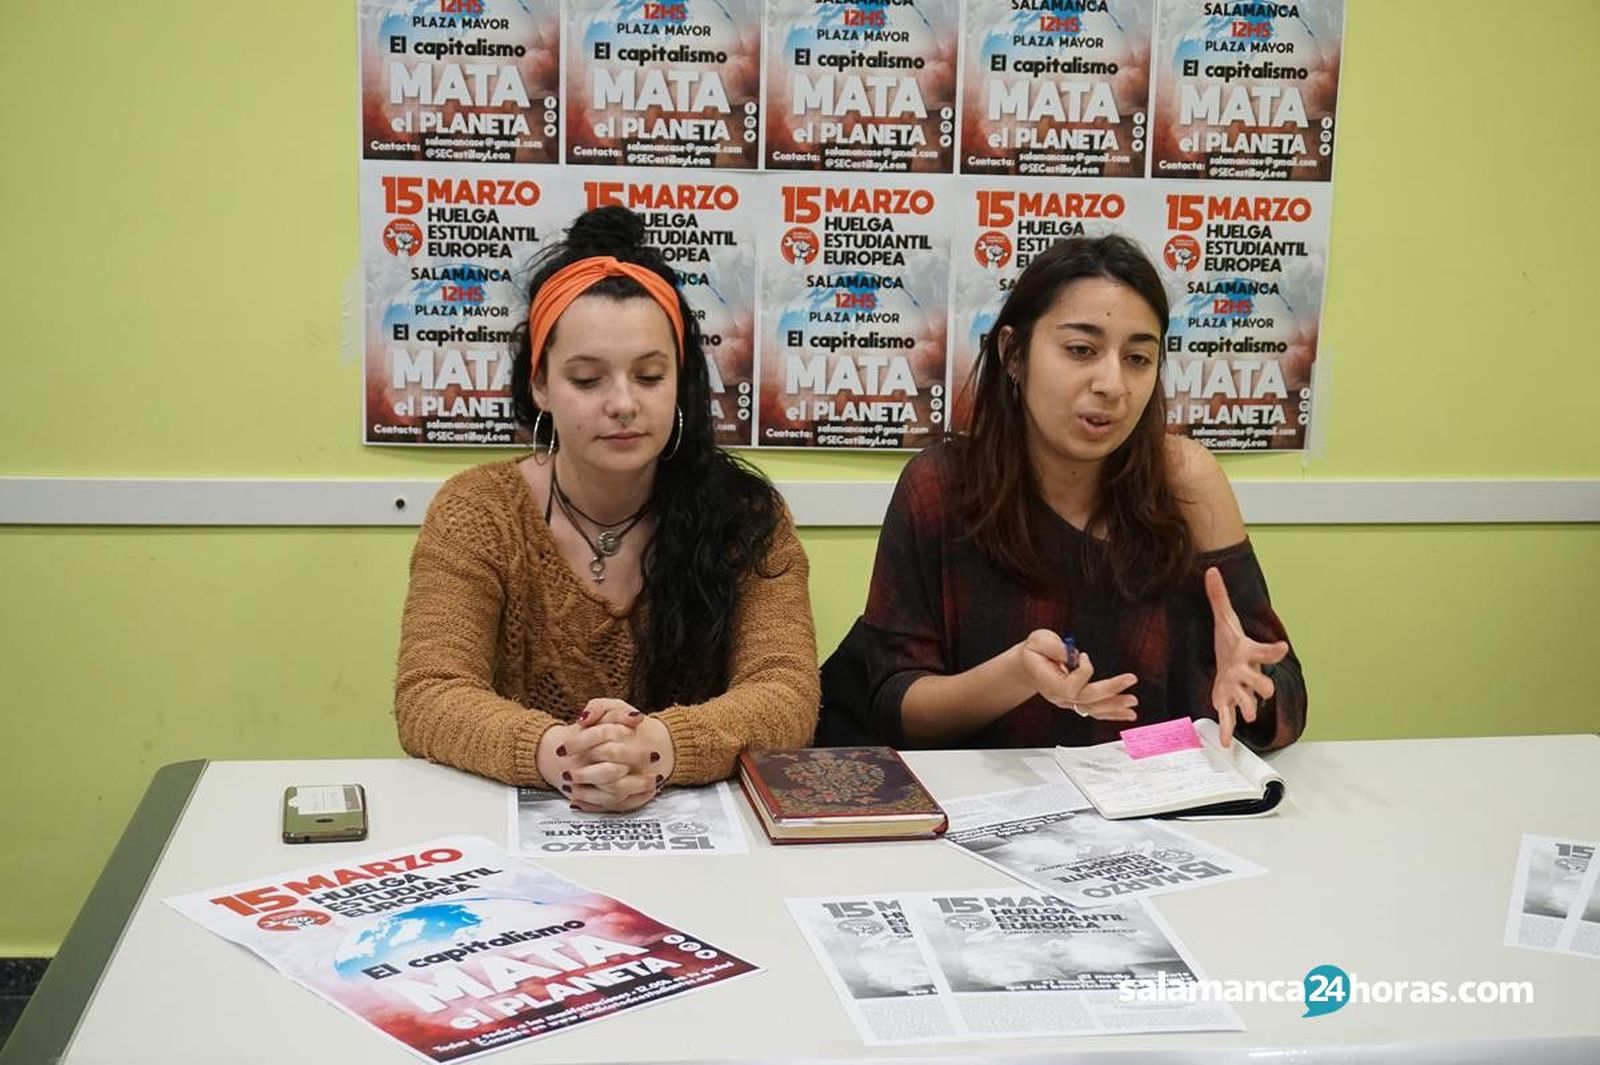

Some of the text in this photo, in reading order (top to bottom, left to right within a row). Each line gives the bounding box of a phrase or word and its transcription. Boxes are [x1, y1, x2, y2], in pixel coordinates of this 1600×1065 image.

[440, 0, 483, 14] 12HS
[643, 3, 688, 20] 12HS
[1012, 0, 1109, 13] SALAMANCA
[1204, 3, 1300, 18] SALAMANCA
[413, 16, 509, 30] PLAZA MAYOR
[843, 10, 886, 27] 12HS
[1040, 16, 1080, 33] 12HS
[616, 23, 711, 37] PLAZA MAYOR
[817, 29, 910, 43] PLAZA MAYOR
[1231, 22, 1273, 38] 12HS
[389, 36, 526, 60] El capitalismo
[1013, 35, 1104, 49] PLAZA MAYOR
[1205, 41, 1294, 54] PLAZA MAYOR
[594, 42, 728, 66] El capitalismo
[794, 48, 926, 72] El capitalismo
[990, 54, 1119, 78] El capitalismo
[1183, 60, 1308, 83] El capitalismo
[390, 62, 531, 108] MATA
[593, 68, 731, 113] MATA
[793, 74, 928, 119] MATA
[989, 80, 1120, 124] MATA
[1180, 84, 1309, 128] MATA
[391, 111, 531, 135] el PLANETA
[593, 117, 731, 141] el PLANETA
[792, 122, 927, 146] el PLANETA
[988, 127, 1119, 150] el PLANETA
[1179, 131, 1307, 154] el PLANETA
[382, 176, 541, 215] 15 MARZO
[629, 184, 740, 211] MARZO
[782, 186, 935, 224] 15 MARZO
[976, 191, 1126, 228] 15 MARZO
[1166, 195, 1313, 231] 15 MARZO
[427, 207, 500, 224] HUELGA
[642, 213, 698, 228] UELGA
[825, 216, 894, 232] HUELGA
[427, 225, 540, 242] ESTUDIANTIL
[1018, 220, 1085, 236] HUELGA
[1206, 224, 1273, 240] HUELGA
[645, 230, 737, 246] TUDIANTIL
[824, 233, 932, 250] ESTUDIANTIL
[427, 242, 513, 259] EUROPEA
[662, 248, 711, 263] OPEA
[1205, 240, 1309, 257] ESTUDIANTIL
[824, 250, 905, 266] EUROPEA
[1204, 257, 1282, 273] EUROPEA
[411, 267, 512, 282] SALAMANCA
[807, 275, 904, 289] SALAMANCA
[441, 286, 484, 303] 12HS
[1187, 281, 1280, 295] SALAMANCA
[835, 292, 876, 308] 12HS
[1213, 298, 1253, 314] 12HS
[415, 304, 509, 317] PLAZA MAYOR
[809, 311, 900, 324] PLAZA MAYOR
[1188, 317, 1274, 329] PLAZA MAYOR
[393, 324, 513, 347] El capitalism
[787, 330, 916, 353] El capitalismo
[1167, 336, 1288, 358] El capitalismo
[785, 354, 918, 396] MATA
[1165, 360, 1288, 399] MATA
[394, 397, 515, 418] el PLANET
[785, 401, 918, 423] el PLANETA
[1189, 405, 1287, 425] PLANETA
[544, 828, 663, 837] ESTUDIANTIL
[569, 823, 661, 831] EUROPEA
[541, 836, 715, 853] 15 MARZO
[586, 834, 664, 842] HUELGA
[1053, 859, 1161, 883] ESTUDIANTIL
[1066, 853, 1147, 873] EUROPEA
[1083, 861, 1232, 898] 15 MARZO
[1103, 864, 1172, 882] HUELGA
[209, 848, 463, 917] 15 MARZO
[308, 873, 426, 904] HUELGA
[322, 867, 502, 912] ESTUDIANTIL
[339, 883, 480, 918] EUROPEA
[932, 896, 1066, 914] 15 MAR
[822, 901, 875, 919] 15
[991, 907, 1076, 915] HUELGA
[994, 914, 1129, 923] ESTUDIANTIL
[999, 921, 1100, 930] EUROPEA
[361, 920, 585, 980] El capitalismo
[392, 934, 650, 1014] MATA
[451, 1008, 494, 1030] el
[489, 957, 683, 1017] PLANETA
